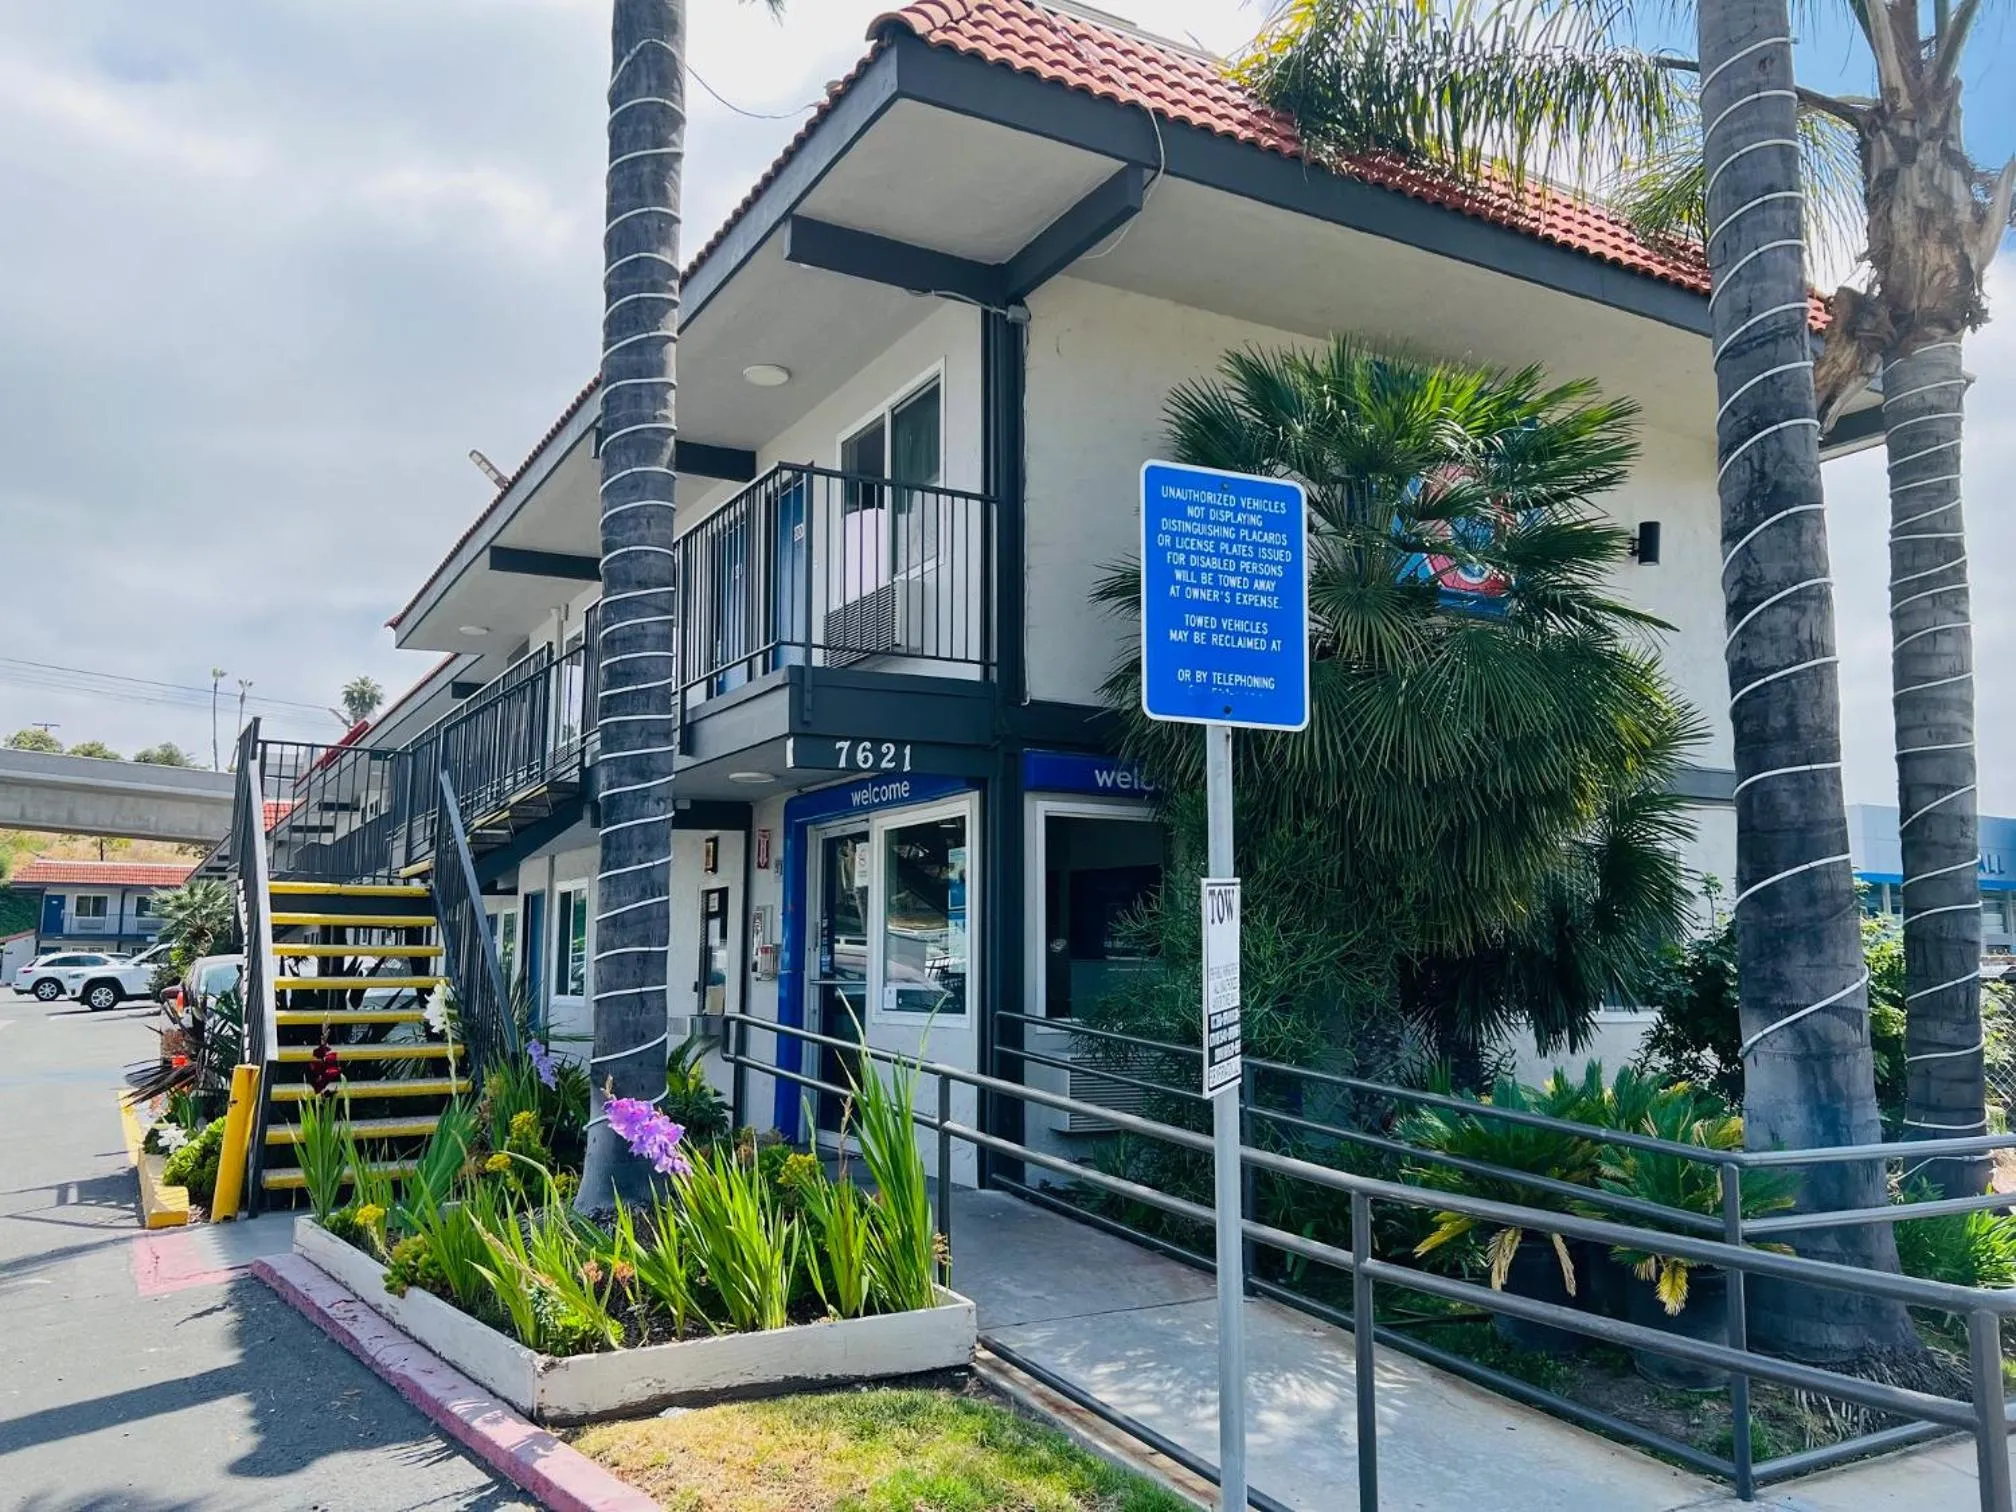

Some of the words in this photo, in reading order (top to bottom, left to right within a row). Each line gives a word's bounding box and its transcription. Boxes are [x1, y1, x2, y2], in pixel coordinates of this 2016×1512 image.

[1161, 486, 1236, 508] UNAUTHORIZED
[1240, 497, 1287, 515] VEHICLES
[1187, 506, 1205, 519] NOT
[1209, 509, 1263, 527] DISPLAYING
[1161, 518, 1236, 540] DISTINGUISHING
[1239, 529, 1287, 546] PLACARDS
[1157, 534, 1171, 547] OR
[1175, 536, 1216, 553] LICENSE
[1219, 542, 1254, 558] PLATES
[1258, 548, 1292, 563] ISSUED
[1167, 552, 1186, 565] FOR
[1189, 555, 1236, 572] DISABLED
[1239, 561, 1283, 578] PERSONS
[1174, 570, 1197, 584] WILL
[1200, 572, 1214, 586] BE
[1217, 574, 1250, 590] TOWED
[1253, 579, 1276, 592] AWAY
[1169, 585, 1181, 598] AT
[1185, 587, 1231, 604] OWNER'S
[1235, 593, 1283, 610] EXPENSE.
[1184, 614, 1217, 629] TOWED
[1221, 618, 1269, 635] VEHICLES
[1169, 630, 1189, 643] MAY
[1193, 632, 1207, 645] BE
[1211, 634, 1267, 651] RECLAIMED
[1270, 640, 1282, 652] AT
[1177, 669, 1191, 682] OR
[1195, 671, 1208, 683] BY
[1212, 672, 1275, 690] TELEPHONING
[835, 740, 911, 772] 7621
[851, 781, 910, 807] welcome
[1208, 888, 1235, 925] TOW
